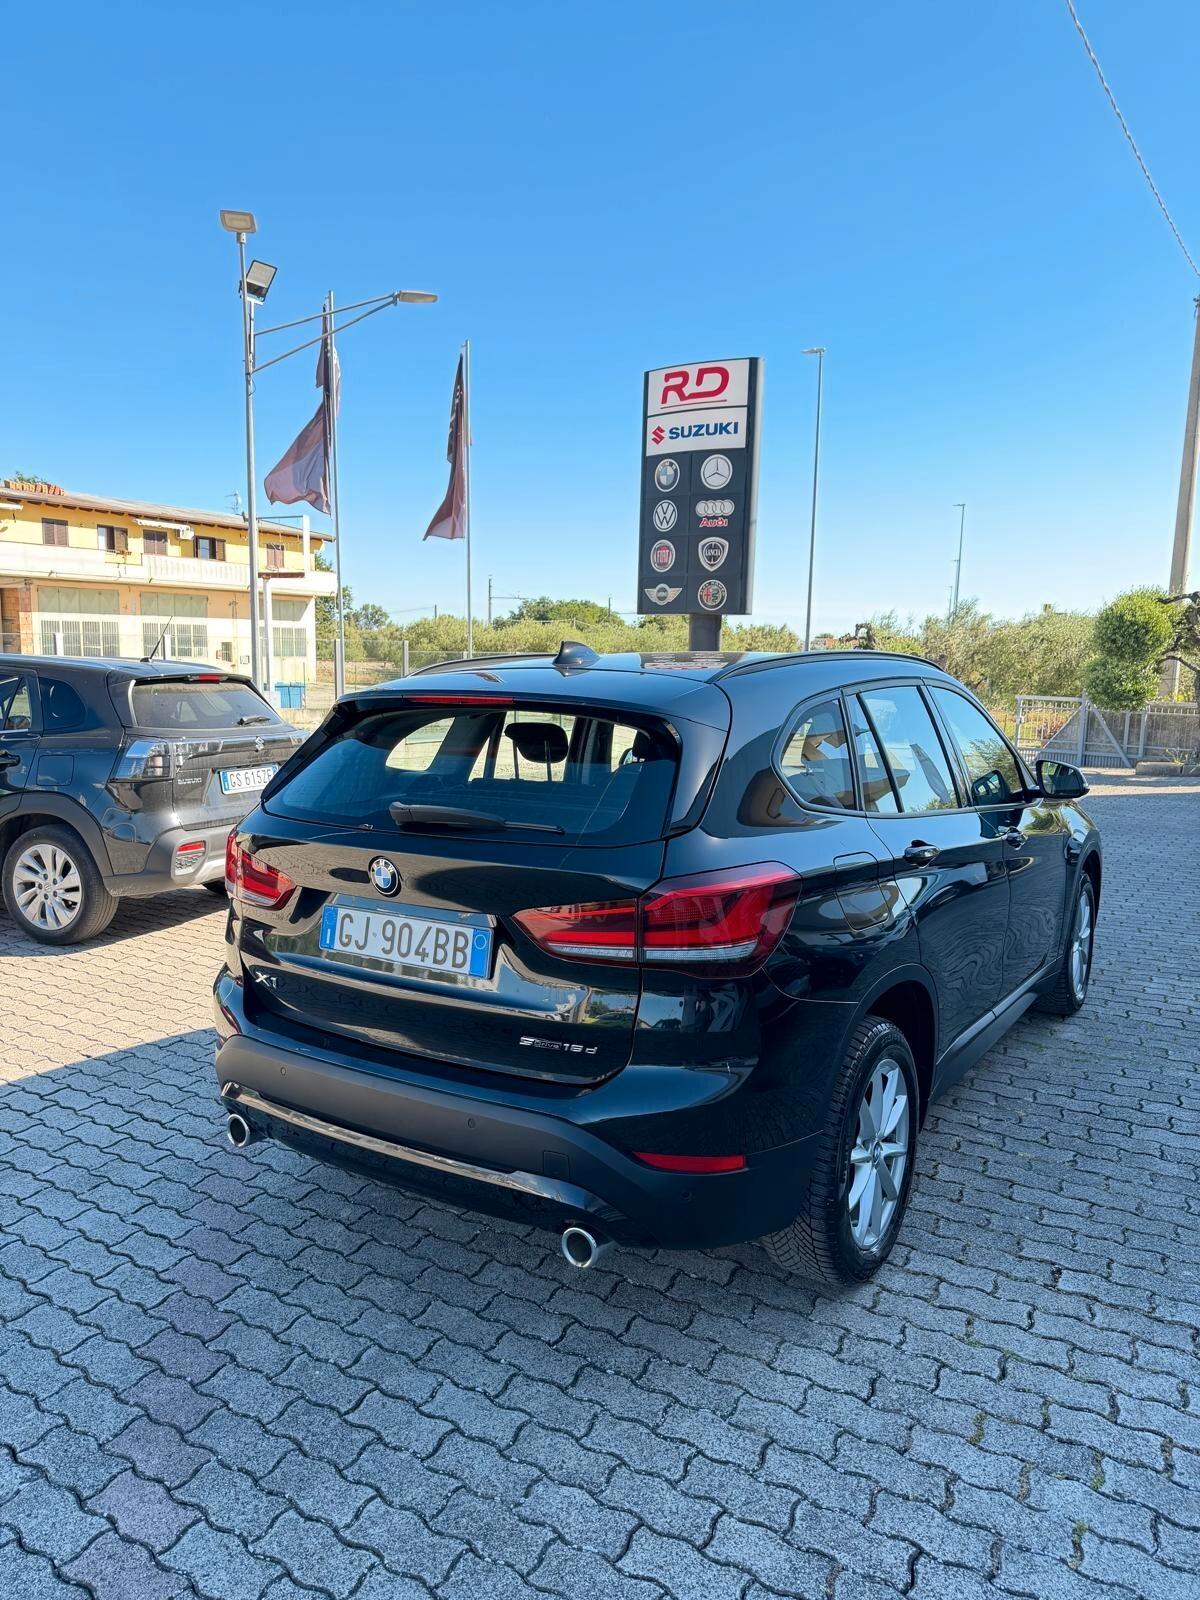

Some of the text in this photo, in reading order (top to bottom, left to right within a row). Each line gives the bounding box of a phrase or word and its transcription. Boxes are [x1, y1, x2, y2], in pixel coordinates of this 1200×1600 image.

[660, 366, 730, 404] RD
[668, 421, 739, 440] SUZUKI
[698, 517, 728, 527] Audi
[229, 772, 243, 788] GS
[338, 913, 371, 951] GJ
[380, 918, 470, 970] 904BB
[255, 971, 279, 989] X1
